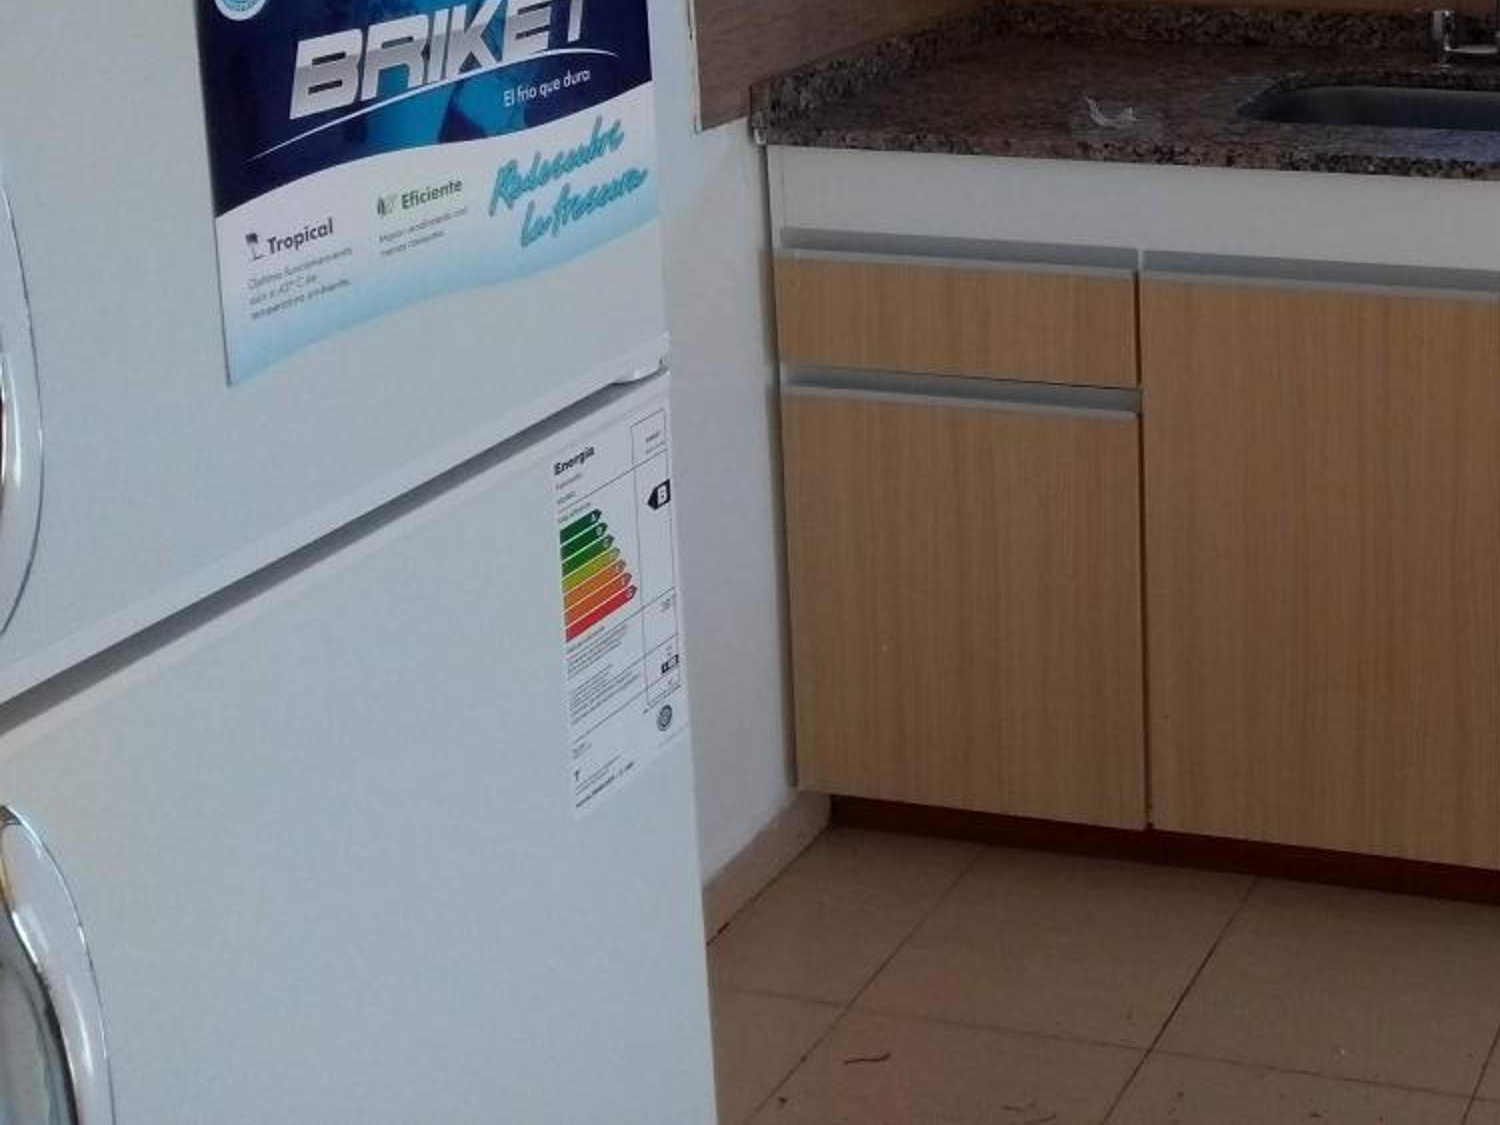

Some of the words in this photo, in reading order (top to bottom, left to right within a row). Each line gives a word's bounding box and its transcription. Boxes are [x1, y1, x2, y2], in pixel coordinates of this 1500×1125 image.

[503, 89, 515, 107] El
[539, 77, 561, 98] que
[563, 69, 591, 88] dura
[401, 179, 463, 210] Eficiente
[267, 216, 334, 254] Tropical
